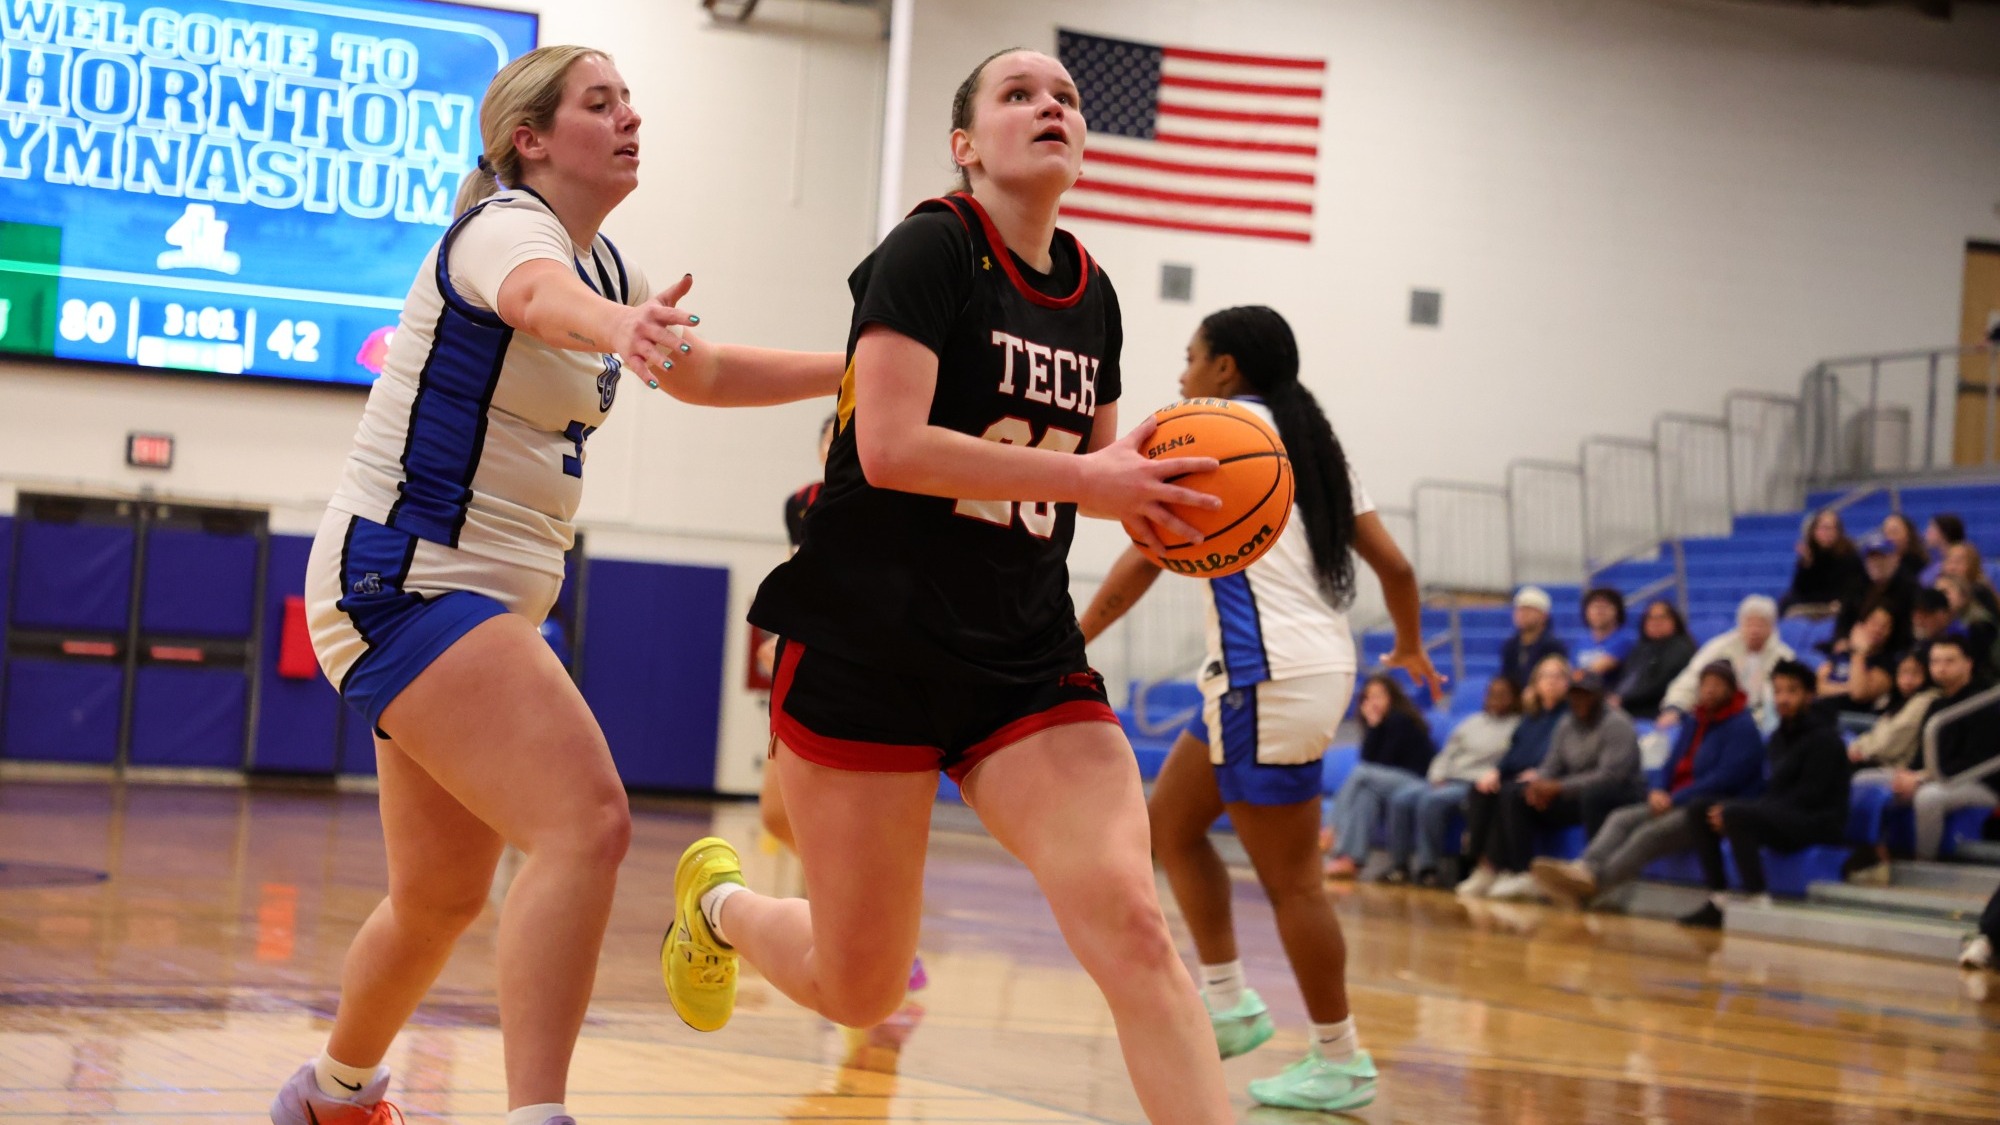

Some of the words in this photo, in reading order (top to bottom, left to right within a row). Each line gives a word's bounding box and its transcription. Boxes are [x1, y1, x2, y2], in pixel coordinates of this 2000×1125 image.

[0, 0, 318, 77] WELCOME
[331, 32, 418, 90] TO
[59, 298, 117, 344] 80
[163, 303, 239, 341] 3:01
[266, 319, 321, 363] 42
[992, 330, 1099, 417] TECH
[1147, 435, 1185, 460] NFHS
[1158, 522, 1274, 574] Wilson
